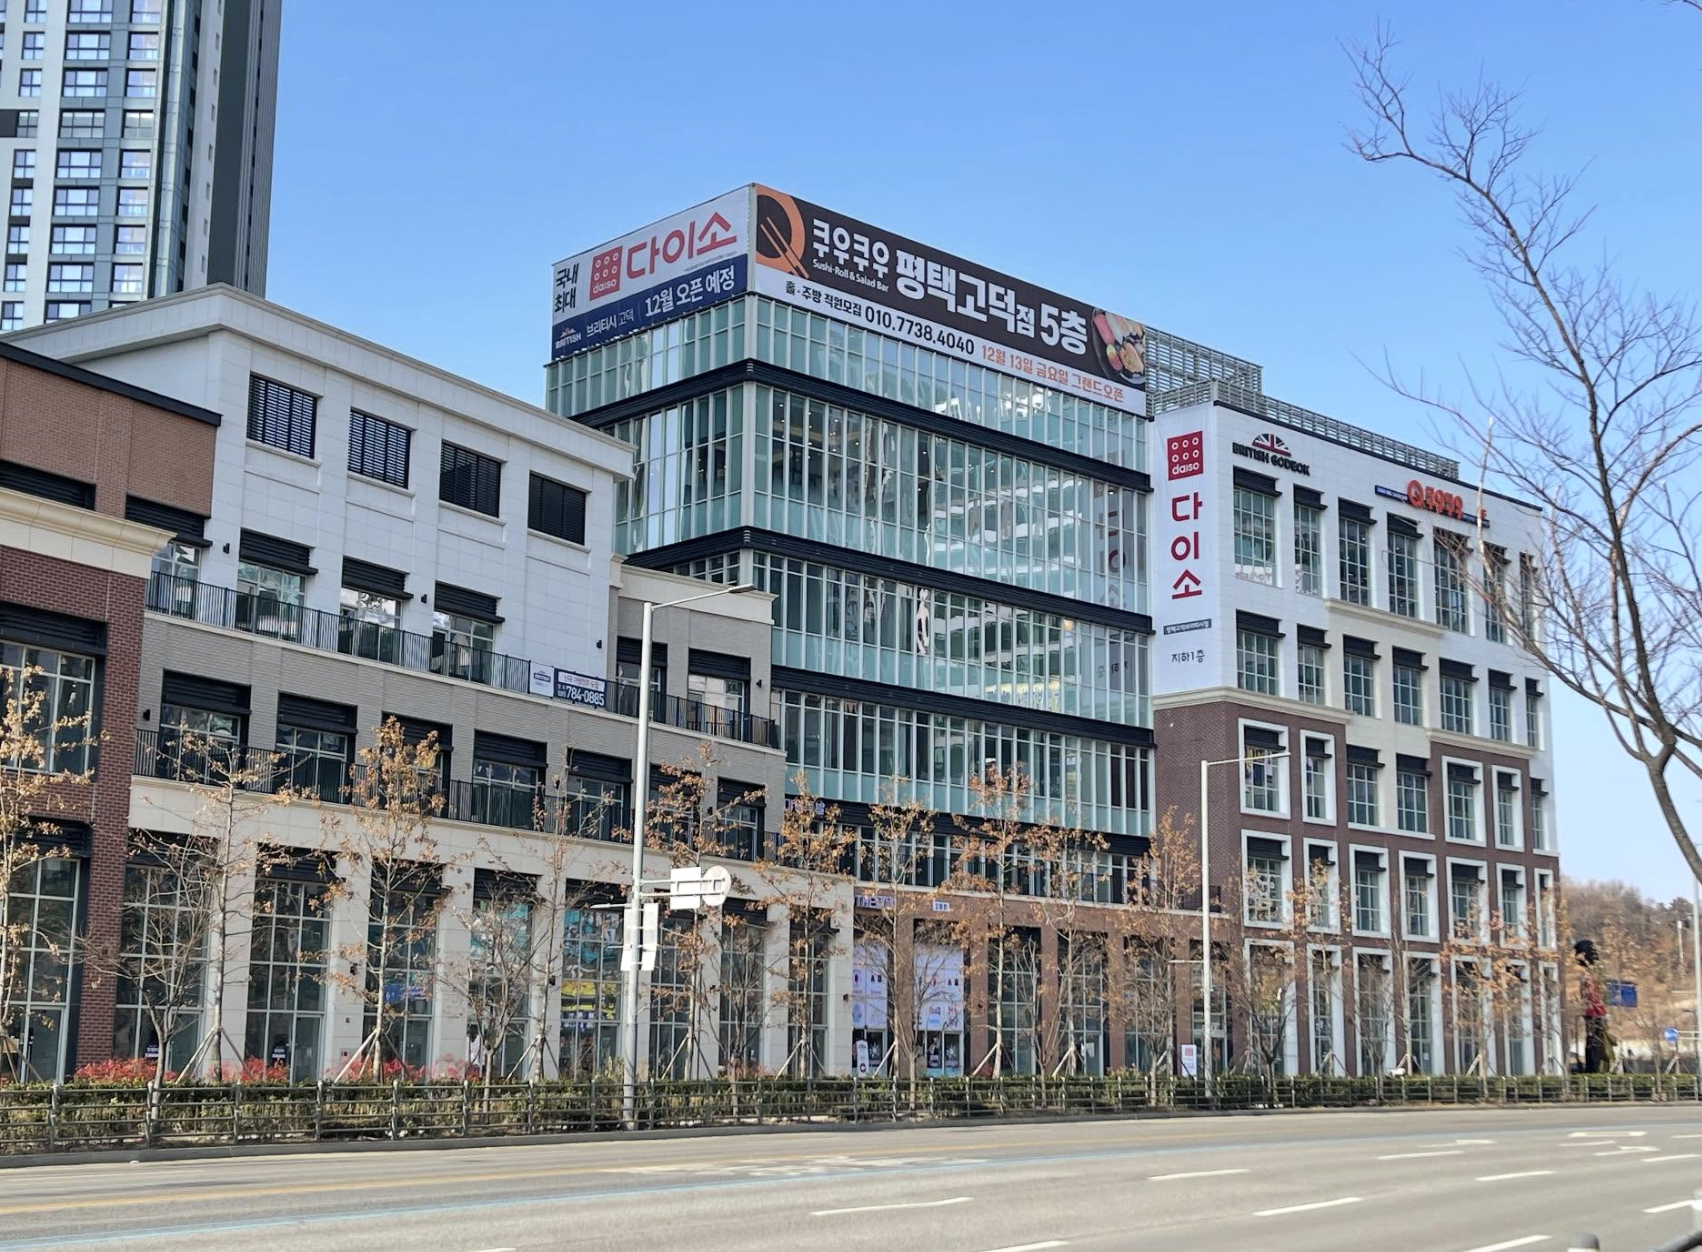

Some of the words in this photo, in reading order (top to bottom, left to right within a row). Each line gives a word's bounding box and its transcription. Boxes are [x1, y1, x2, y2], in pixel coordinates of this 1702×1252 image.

[626, 211, 738, 279] 다이소
[555, 262, 579, 289] 국내
[592, 279, 617, 294] daiso
[812, 218, 890, 279] 쿠우쿠우
[896, 249, 1036, 339] 평택고덕점
[1040, 302, 1089, 356] 5층
[849, 271, 856, 281] &
[856, 273, 876, 288] Salad
[876, 280, 889, 292] Bar
[554, 286, 577, 313] 최대
[645, 286, 675, 317] 12월
[676, 277, 703, 306] 오픈
[705, 265, 735, 294] 예정
[586, 314, 617, 338] 브리티시
[618, 308, 634, 326] 고덕
[555, 332, 582, 350] BRITISH
[824, 293, 862, 318] 직원모집
[865, 305, 975, 355] 010.7738.4040
[982, 344, 1006, 366] 12월
[1010, 354, 1033, 374] 13일
[1036, 362, 1069, 386] 금요일
[1072, 373, 1124, 403] 그랜드오픈
[1172, 462, 1200, 475] daiso
[1232, 441, 1270, 464] BRITISH
[1271, 454, 1311, 477] GODEOK
[1170, 491, 1203, 600] 다이소
[1171, 649, 1206, 663] 지하1층
